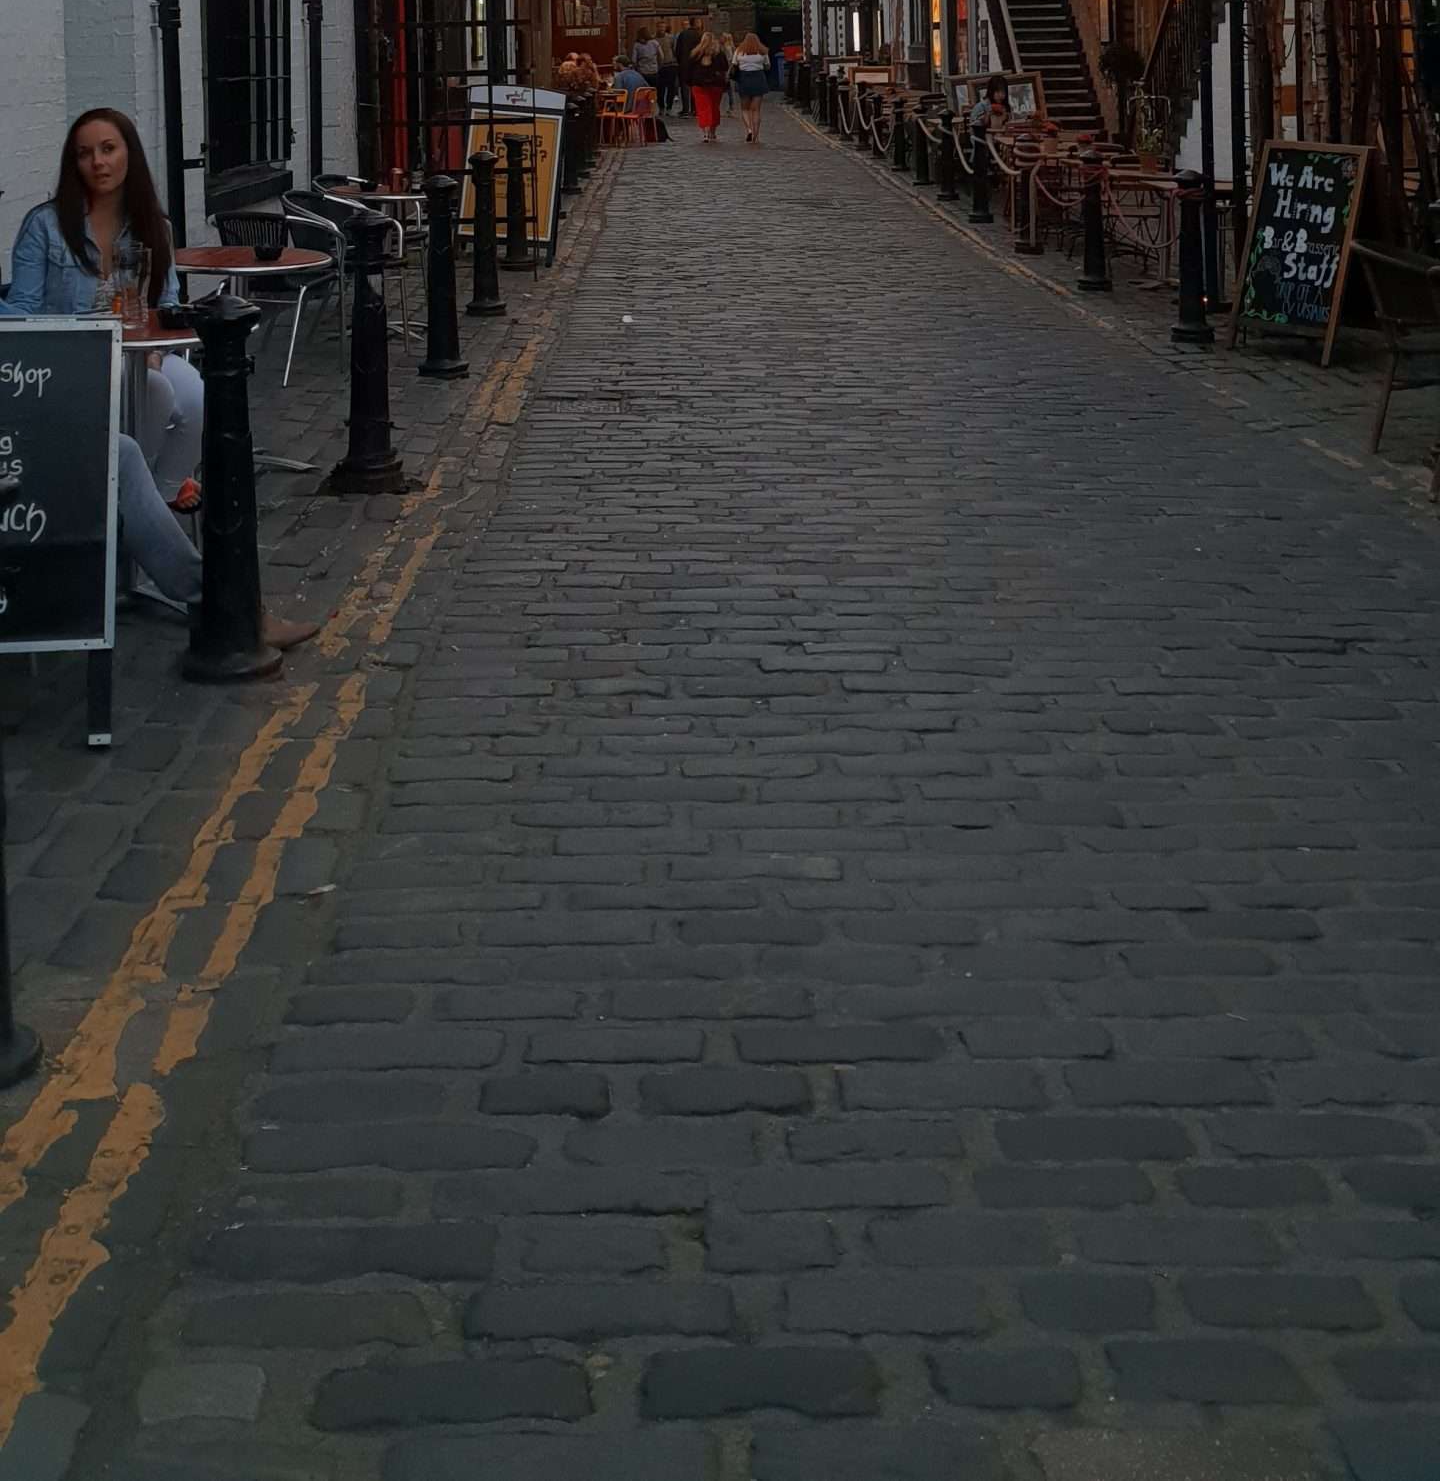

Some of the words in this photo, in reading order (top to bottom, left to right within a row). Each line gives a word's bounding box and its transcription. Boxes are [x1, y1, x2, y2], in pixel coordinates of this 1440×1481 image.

[1268, 162, 1295, 187] We
[1298, 165, 1336, 193] Are
[1283, 252, 1341, 289] Staff
